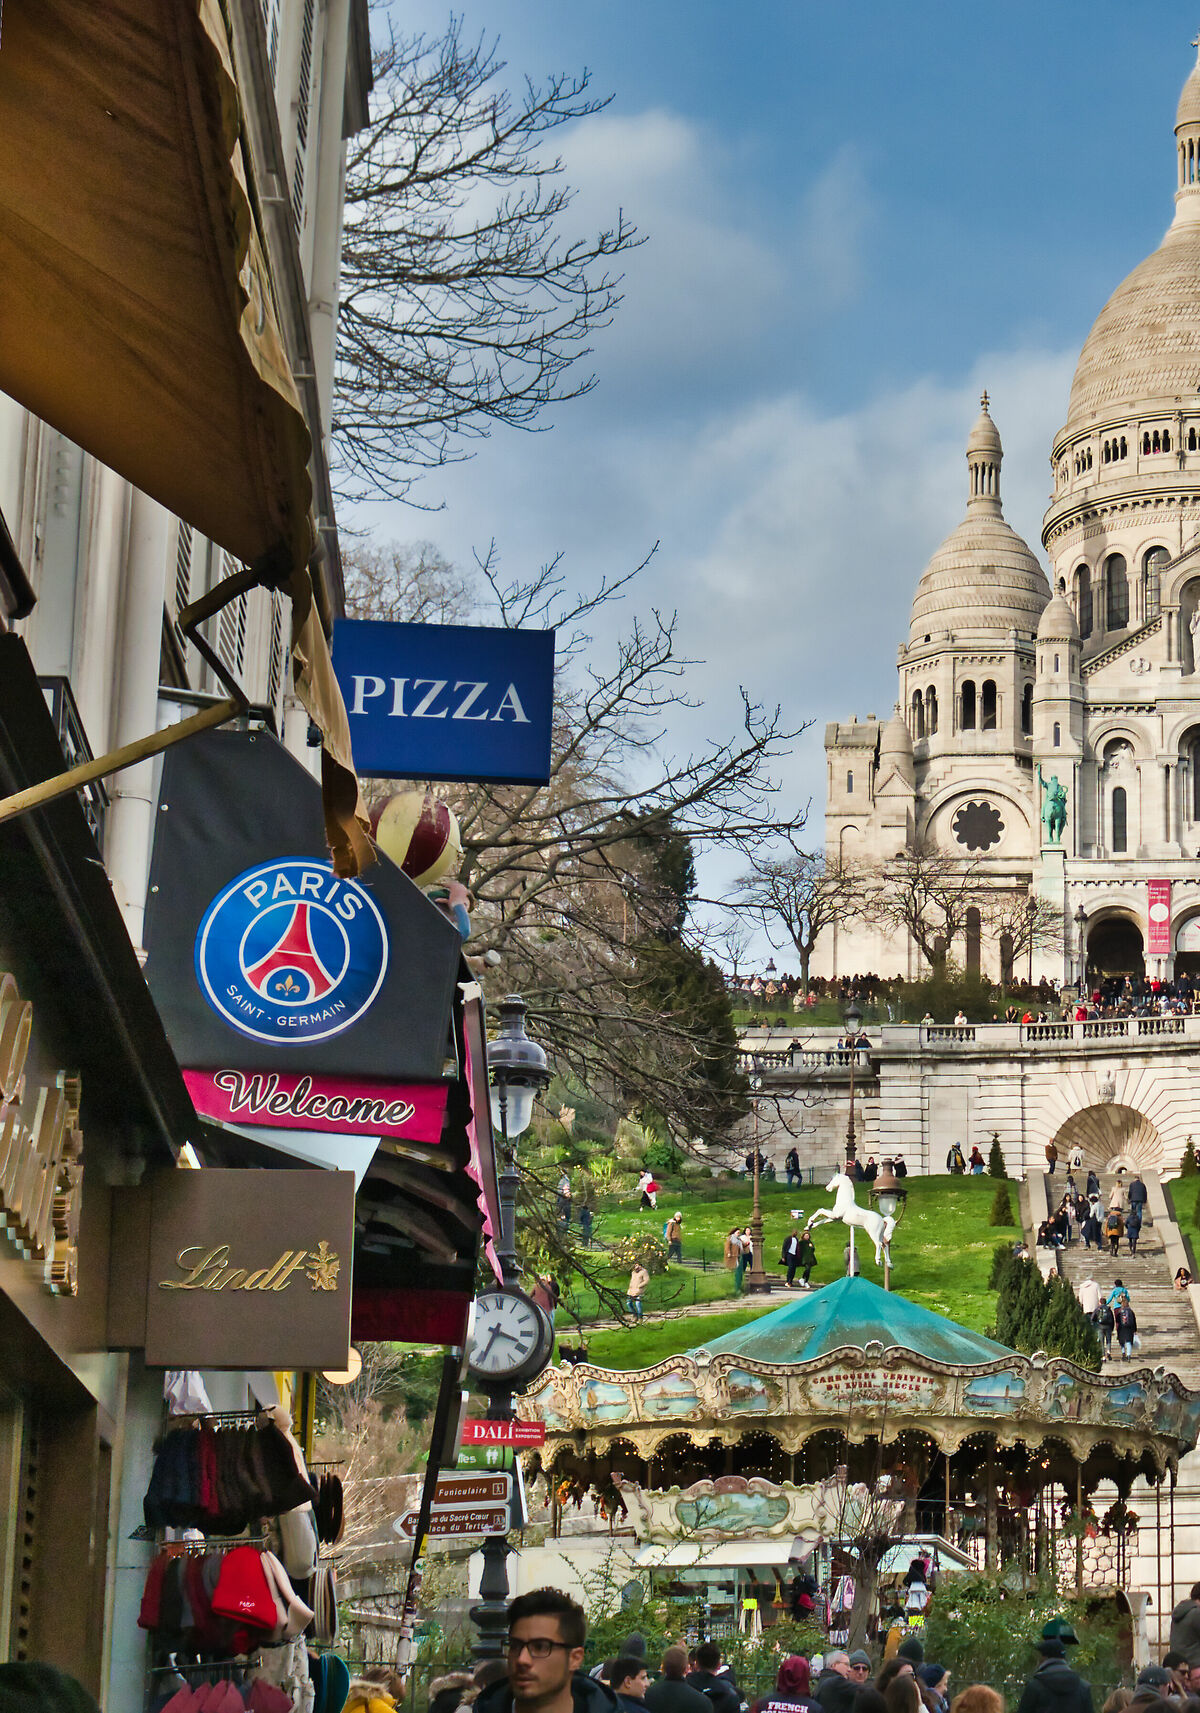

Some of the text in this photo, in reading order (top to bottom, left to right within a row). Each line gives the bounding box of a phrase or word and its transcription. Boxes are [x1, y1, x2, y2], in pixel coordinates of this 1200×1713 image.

[349, 675, 532, 723] PIZZA
[243, 871, 363, 921] PARIS
[226, 984, 265, 1019] SAINT
[276, 1000, 346, 1027] GERMAIN
[213, 1069, 416, 1125] Welcome
[158, 1245, 308, 1291] Lindt
[473, 1422, 514, 1439] DALÍ
[438, 1487, 488, 1497] Funiculaire
[439, 1514, 449, 1523] du
[449, 1513, 469, 1523] Sacré
[767, 1701, 809, 1713] FRENCH
